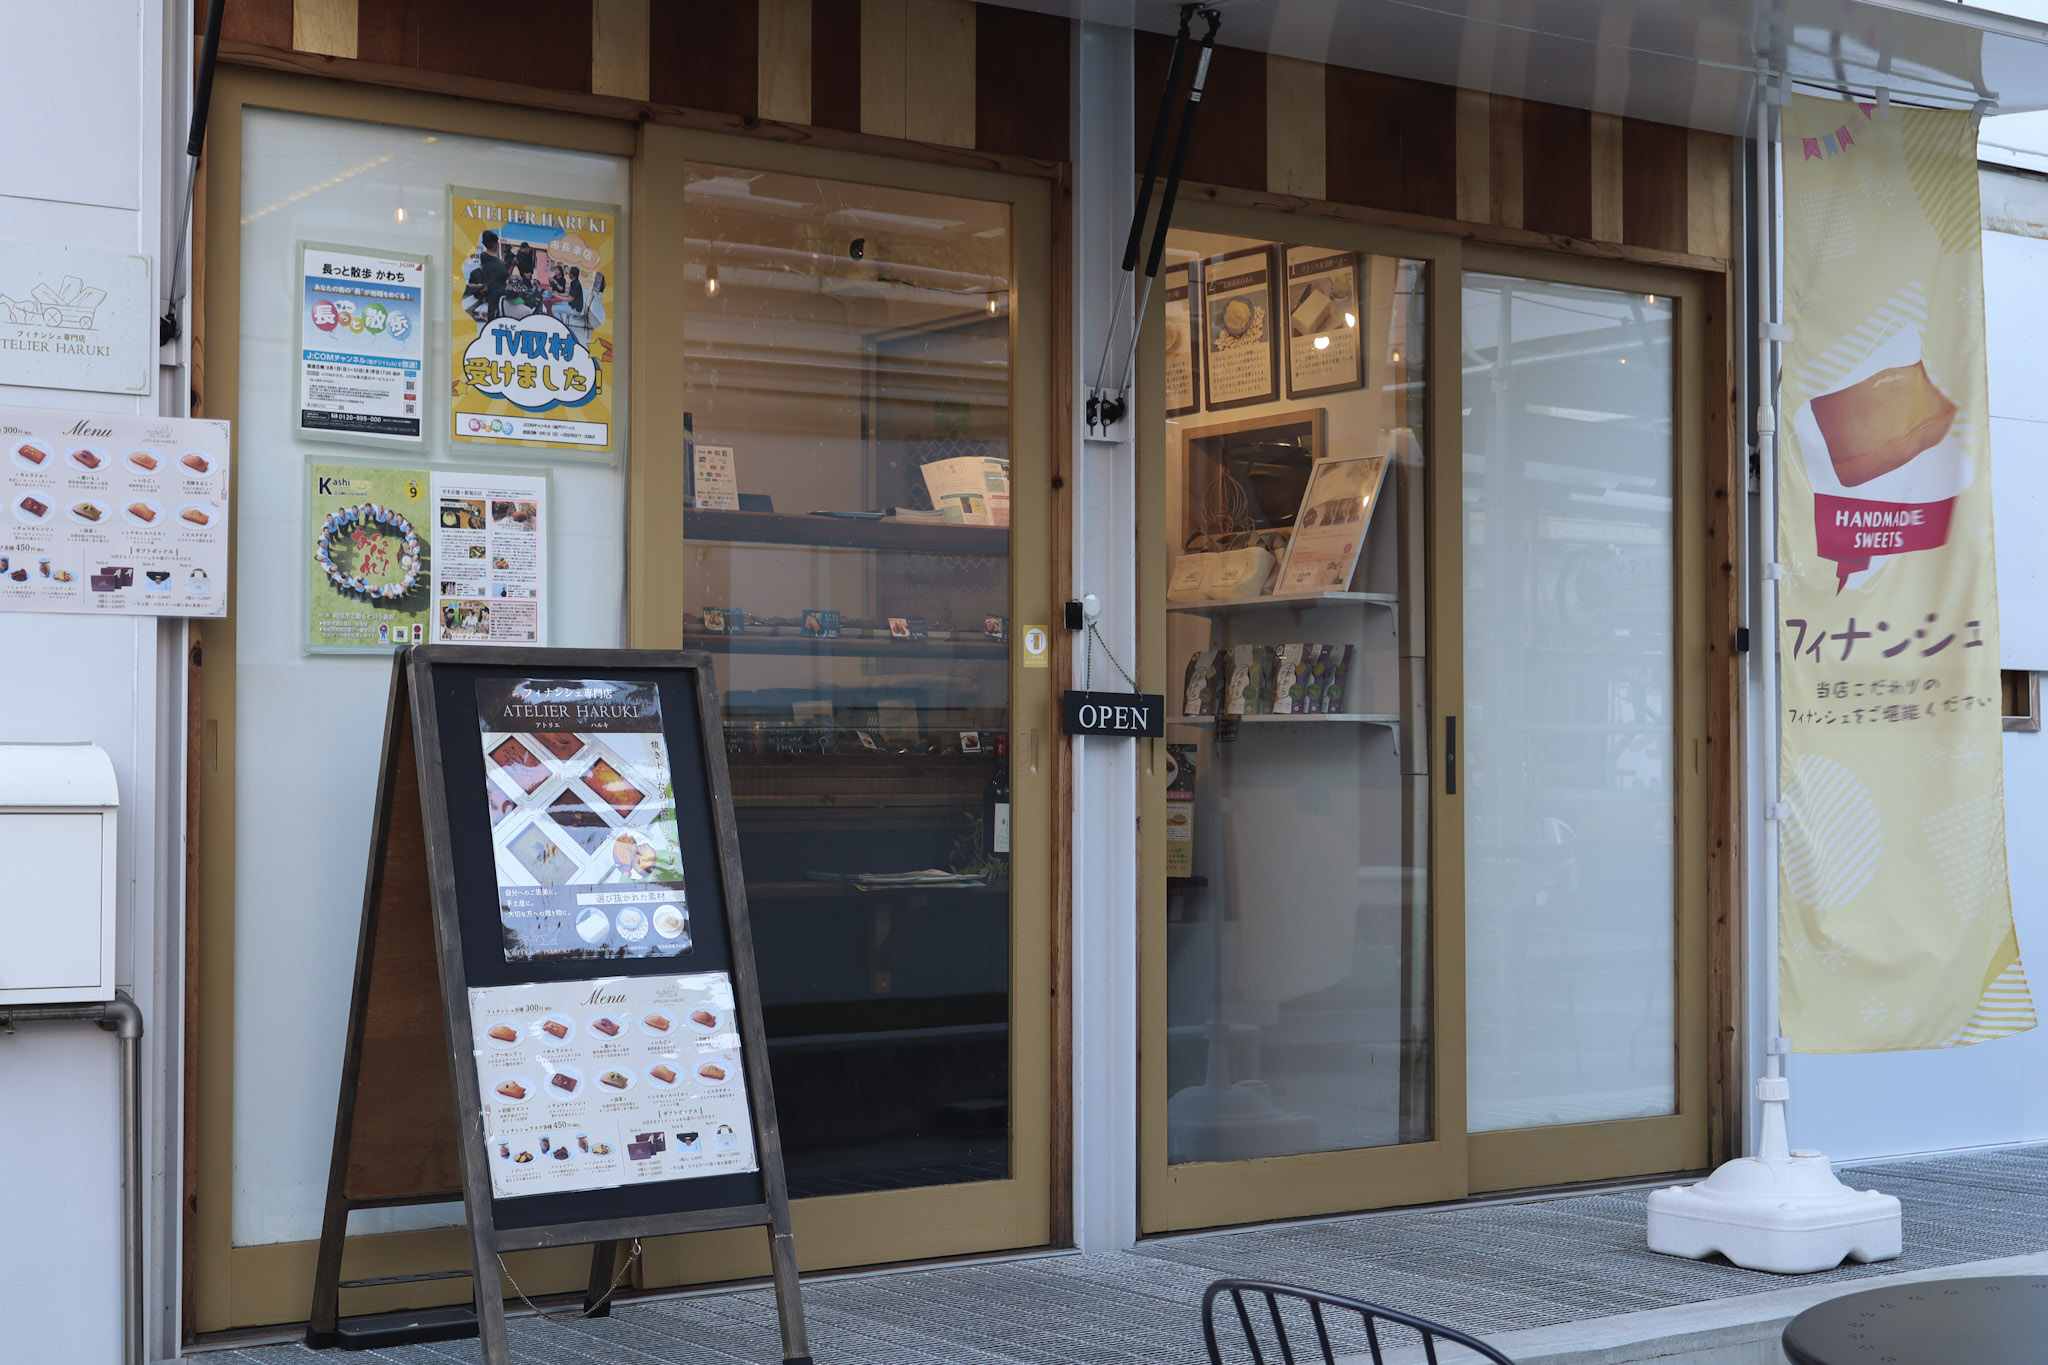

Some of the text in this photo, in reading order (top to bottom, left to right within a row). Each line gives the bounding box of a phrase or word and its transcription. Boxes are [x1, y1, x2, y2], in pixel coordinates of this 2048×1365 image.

[462, 204, 606, 233] ATELIER HARUKI
[322, 263, 405, 282] 長っと散歩 かわち
[498, 323, 516, 331] テレビ
[17, 330, 86, 343] フィナンシェ専門店
[492, 329, 576, 362] TV取材
[0, 338, 110, 357] TELIER HARUKI
[464, 357, 603, 396] 受けました!
[338, 413, 382, 422] 0120-999-000
[62, 420, 113, 438] Menu
[409, 487, 418, 498] 9
[1835, 509, 1926, 528] HANDMADE
[1853, 531, 1904, 549] SWEETS
[1785, 612, 1984, 663] フィナンシェ
[523, 687, 614, 699] フィナンシェ専門店
[1816, 678, 1942, 699] 当店こだわりの
[503, 704, 639, 718] ATELIER HARUKI
[1078, 704, 1149, 731] OPEN
[1789, 695, 1992, 724] フィナンシェをご堪能ください
[505, 888, 558, 897] 自分へのご褒美に。
[596, 892, 666, 904] 選び抜かれた素材
[507, 909, 571, 918] 大切な方への贈り物に。
[580, 987, 626, 1006] Menu
[500, 1124, 552, 1135] フィナンシェラスク各種
